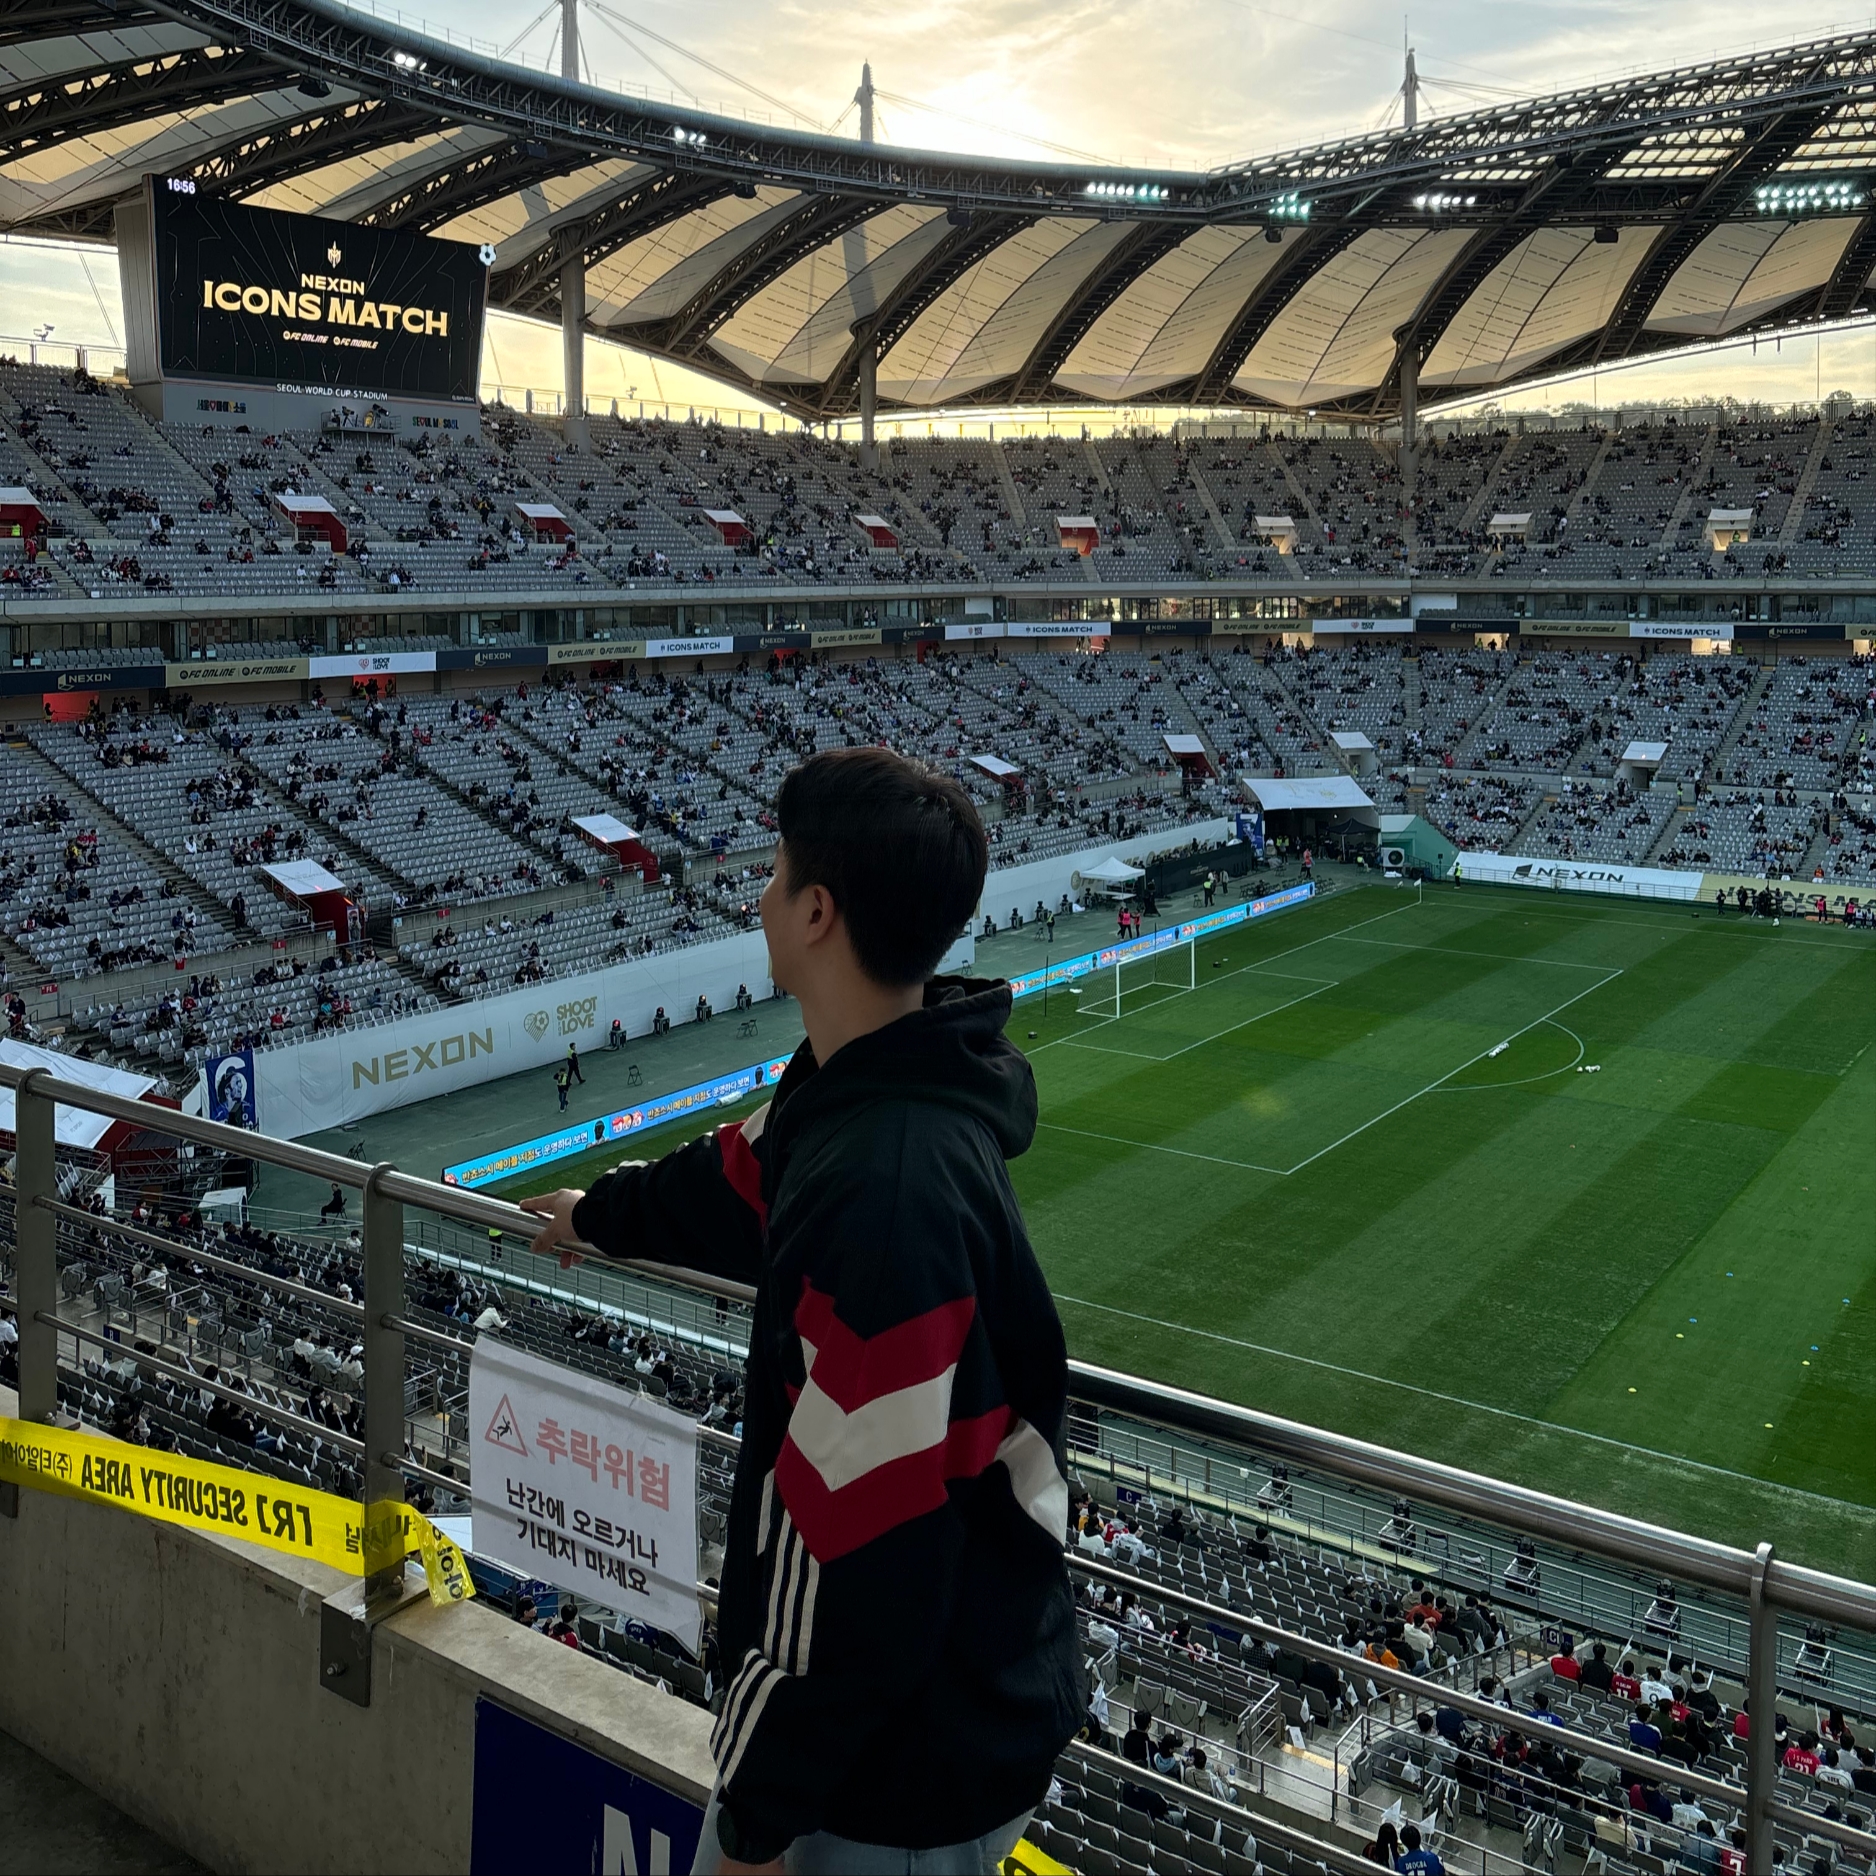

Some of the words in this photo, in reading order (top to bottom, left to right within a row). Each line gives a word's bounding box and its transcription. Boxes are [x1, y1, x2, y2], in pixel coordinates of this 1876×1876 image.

[167, 178, 196, 194] 16:56
[301, 273, 365, 295] NEXON
[203, 280, 322, 321] ICONS
[327, 297, 448, 336] MATCH
[301, 333, 329, 344] ONLINE
[350, 339, 379, 349] MOBILE
[276, 383, 302, 393] SEOUL
[305, 386, 333, 396] WORLD
[335, 388, 351, 397] CUP
[353, 390, 388, 400] STADIUM
[1652, 627, 1682, 635] ICONS
[1684, 628, 1720, 636] MATCH
[572, 649, 595, 657] ONLINE
[614, 646, 637, 654] MOBILE
[667, 643, 692, 652] ICONS
[693, 642, 720, 651] MATCH
[482, 652, 512, 660] NEXON
[188, 670, 202, 679] FC
[202, 668, 236, 678] ONLINE
[250, 667, 264, 675] FC
[263, 665, 297, 675] MOBILE
[68, 673, 112, 684] NEXON
[1536, 867, 1624, 883] NEXON
[556, 995, 598, 1021] SHOOT
[562, 1012, 594, 1036] LOVE
[352, 1027, 494, 1090] NEXON
[495, 1156, 518, 1171] 메이플
[543, 1138, 573, 1156] 운영하다
[573, 1131, 588, 1146] 보면
[535, 1416, 670, 1512] 추락위험
[505, 1477, 565, 1529] 난간에
[572, 1509, 658, 1569] 오르거나
[517, 1517, 577, 1568] 기대지
[584, 1548, 650, 1596] 마세요
